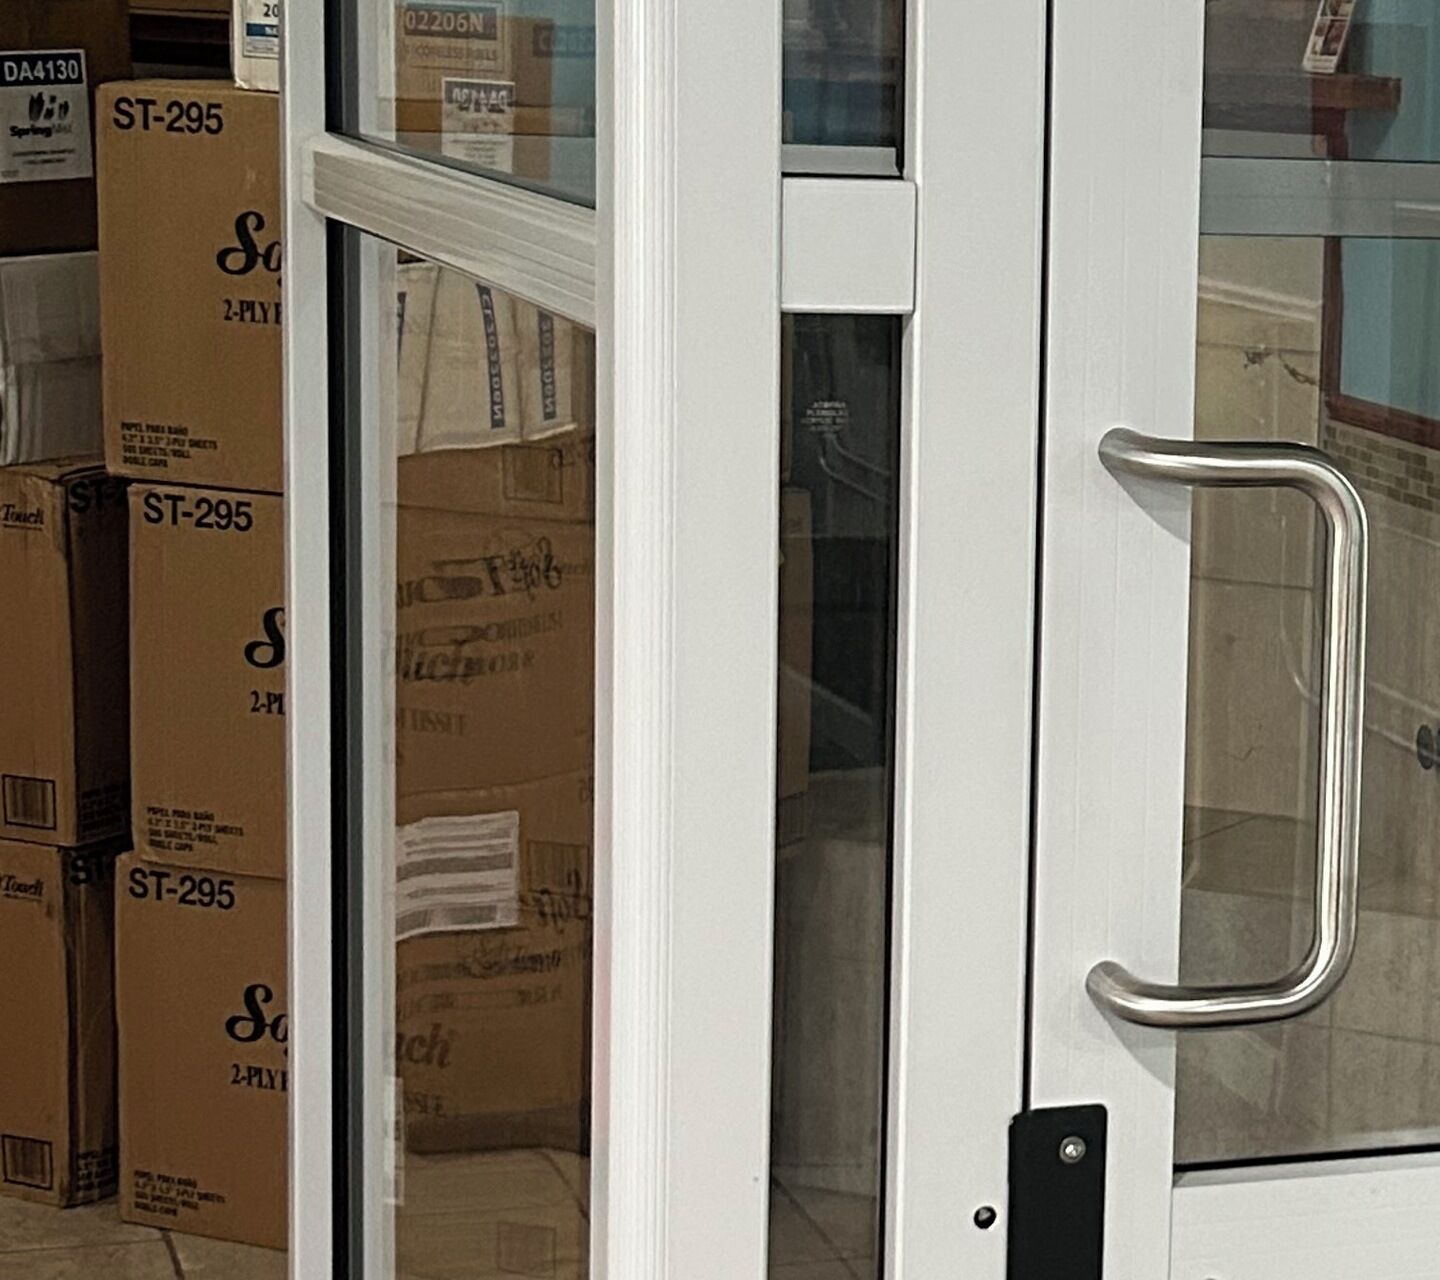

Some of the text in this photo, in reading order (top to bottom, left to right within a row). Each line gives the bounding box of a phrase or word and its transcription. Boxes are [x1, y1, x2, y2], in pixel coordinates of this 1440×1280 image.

[4, 60, 79, 81] DA4130
[113, 97, 224, 135] ST-295
[143, 492, 253, 532] ST-295
[129, 867, 235, 910] ST-295
